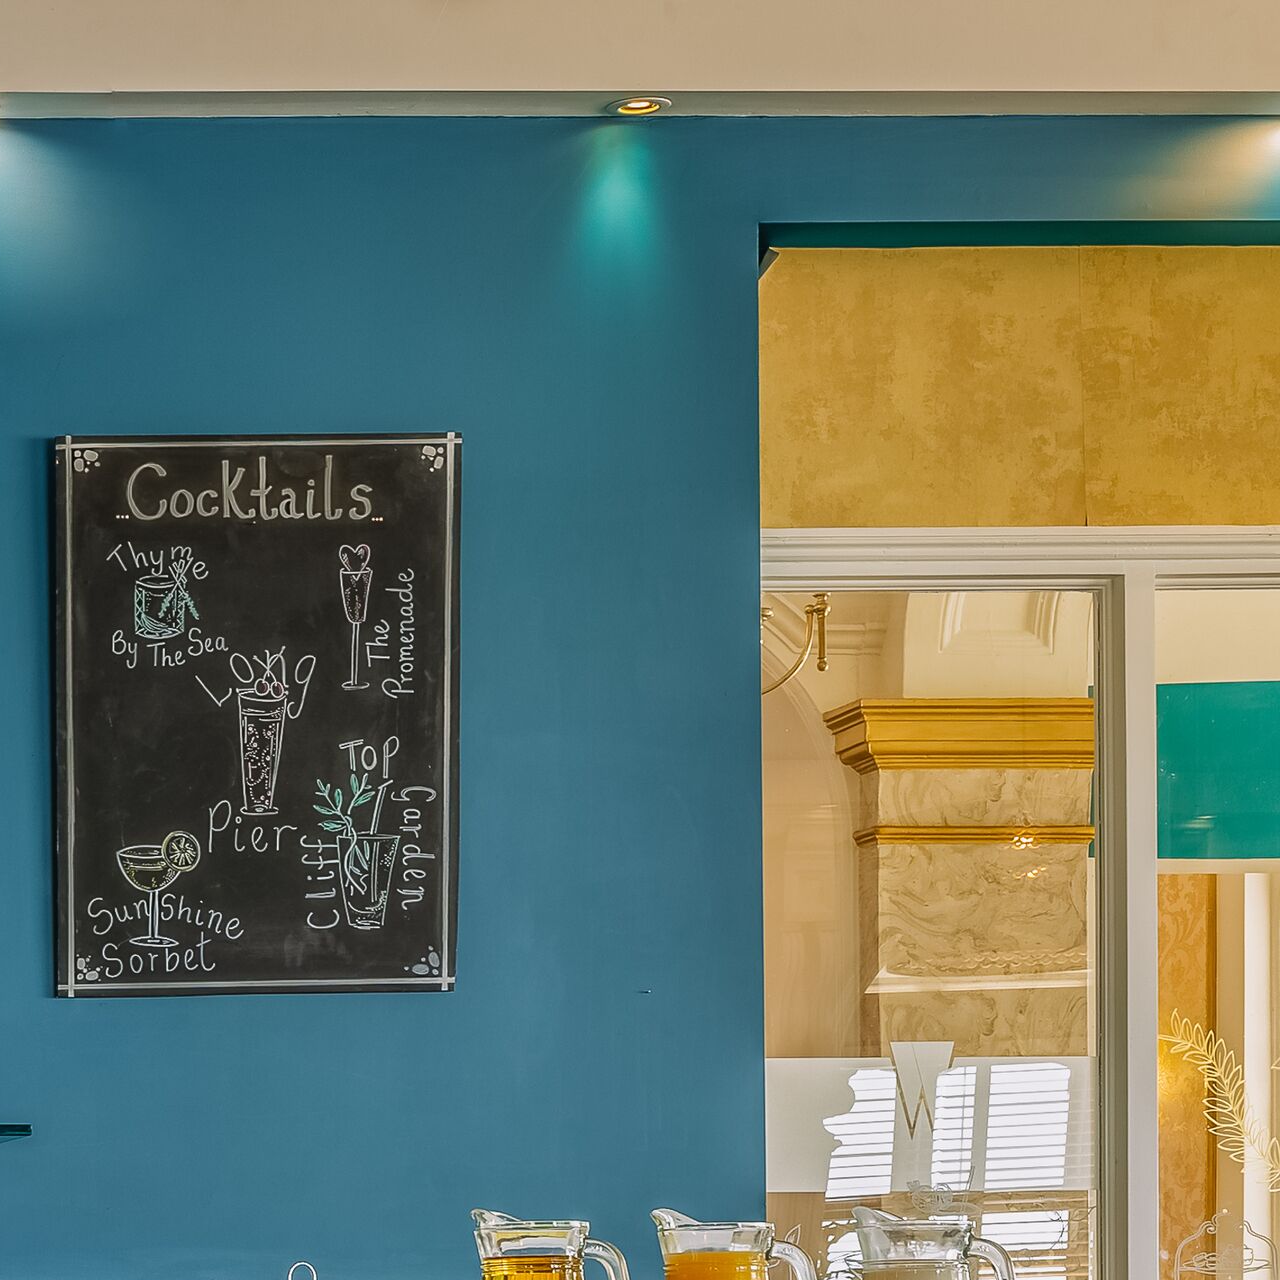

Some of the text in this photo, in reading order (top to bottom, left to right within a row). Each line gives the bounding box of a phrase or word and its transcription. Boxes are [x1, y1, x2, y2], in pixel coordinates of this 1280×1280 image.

[106, 540, 210, 581] Thyme
[112, 627, 230, 669] By The Sea
[365, 619, 392, 668] The
[382, 567, 415, 699] Promenade
[208, 799, 299, 853] Pier
[389, 785, 438, 911] Garden
[299, 834, 340, 930] Cliff
[102, 930, 217, 979] Sorbet
